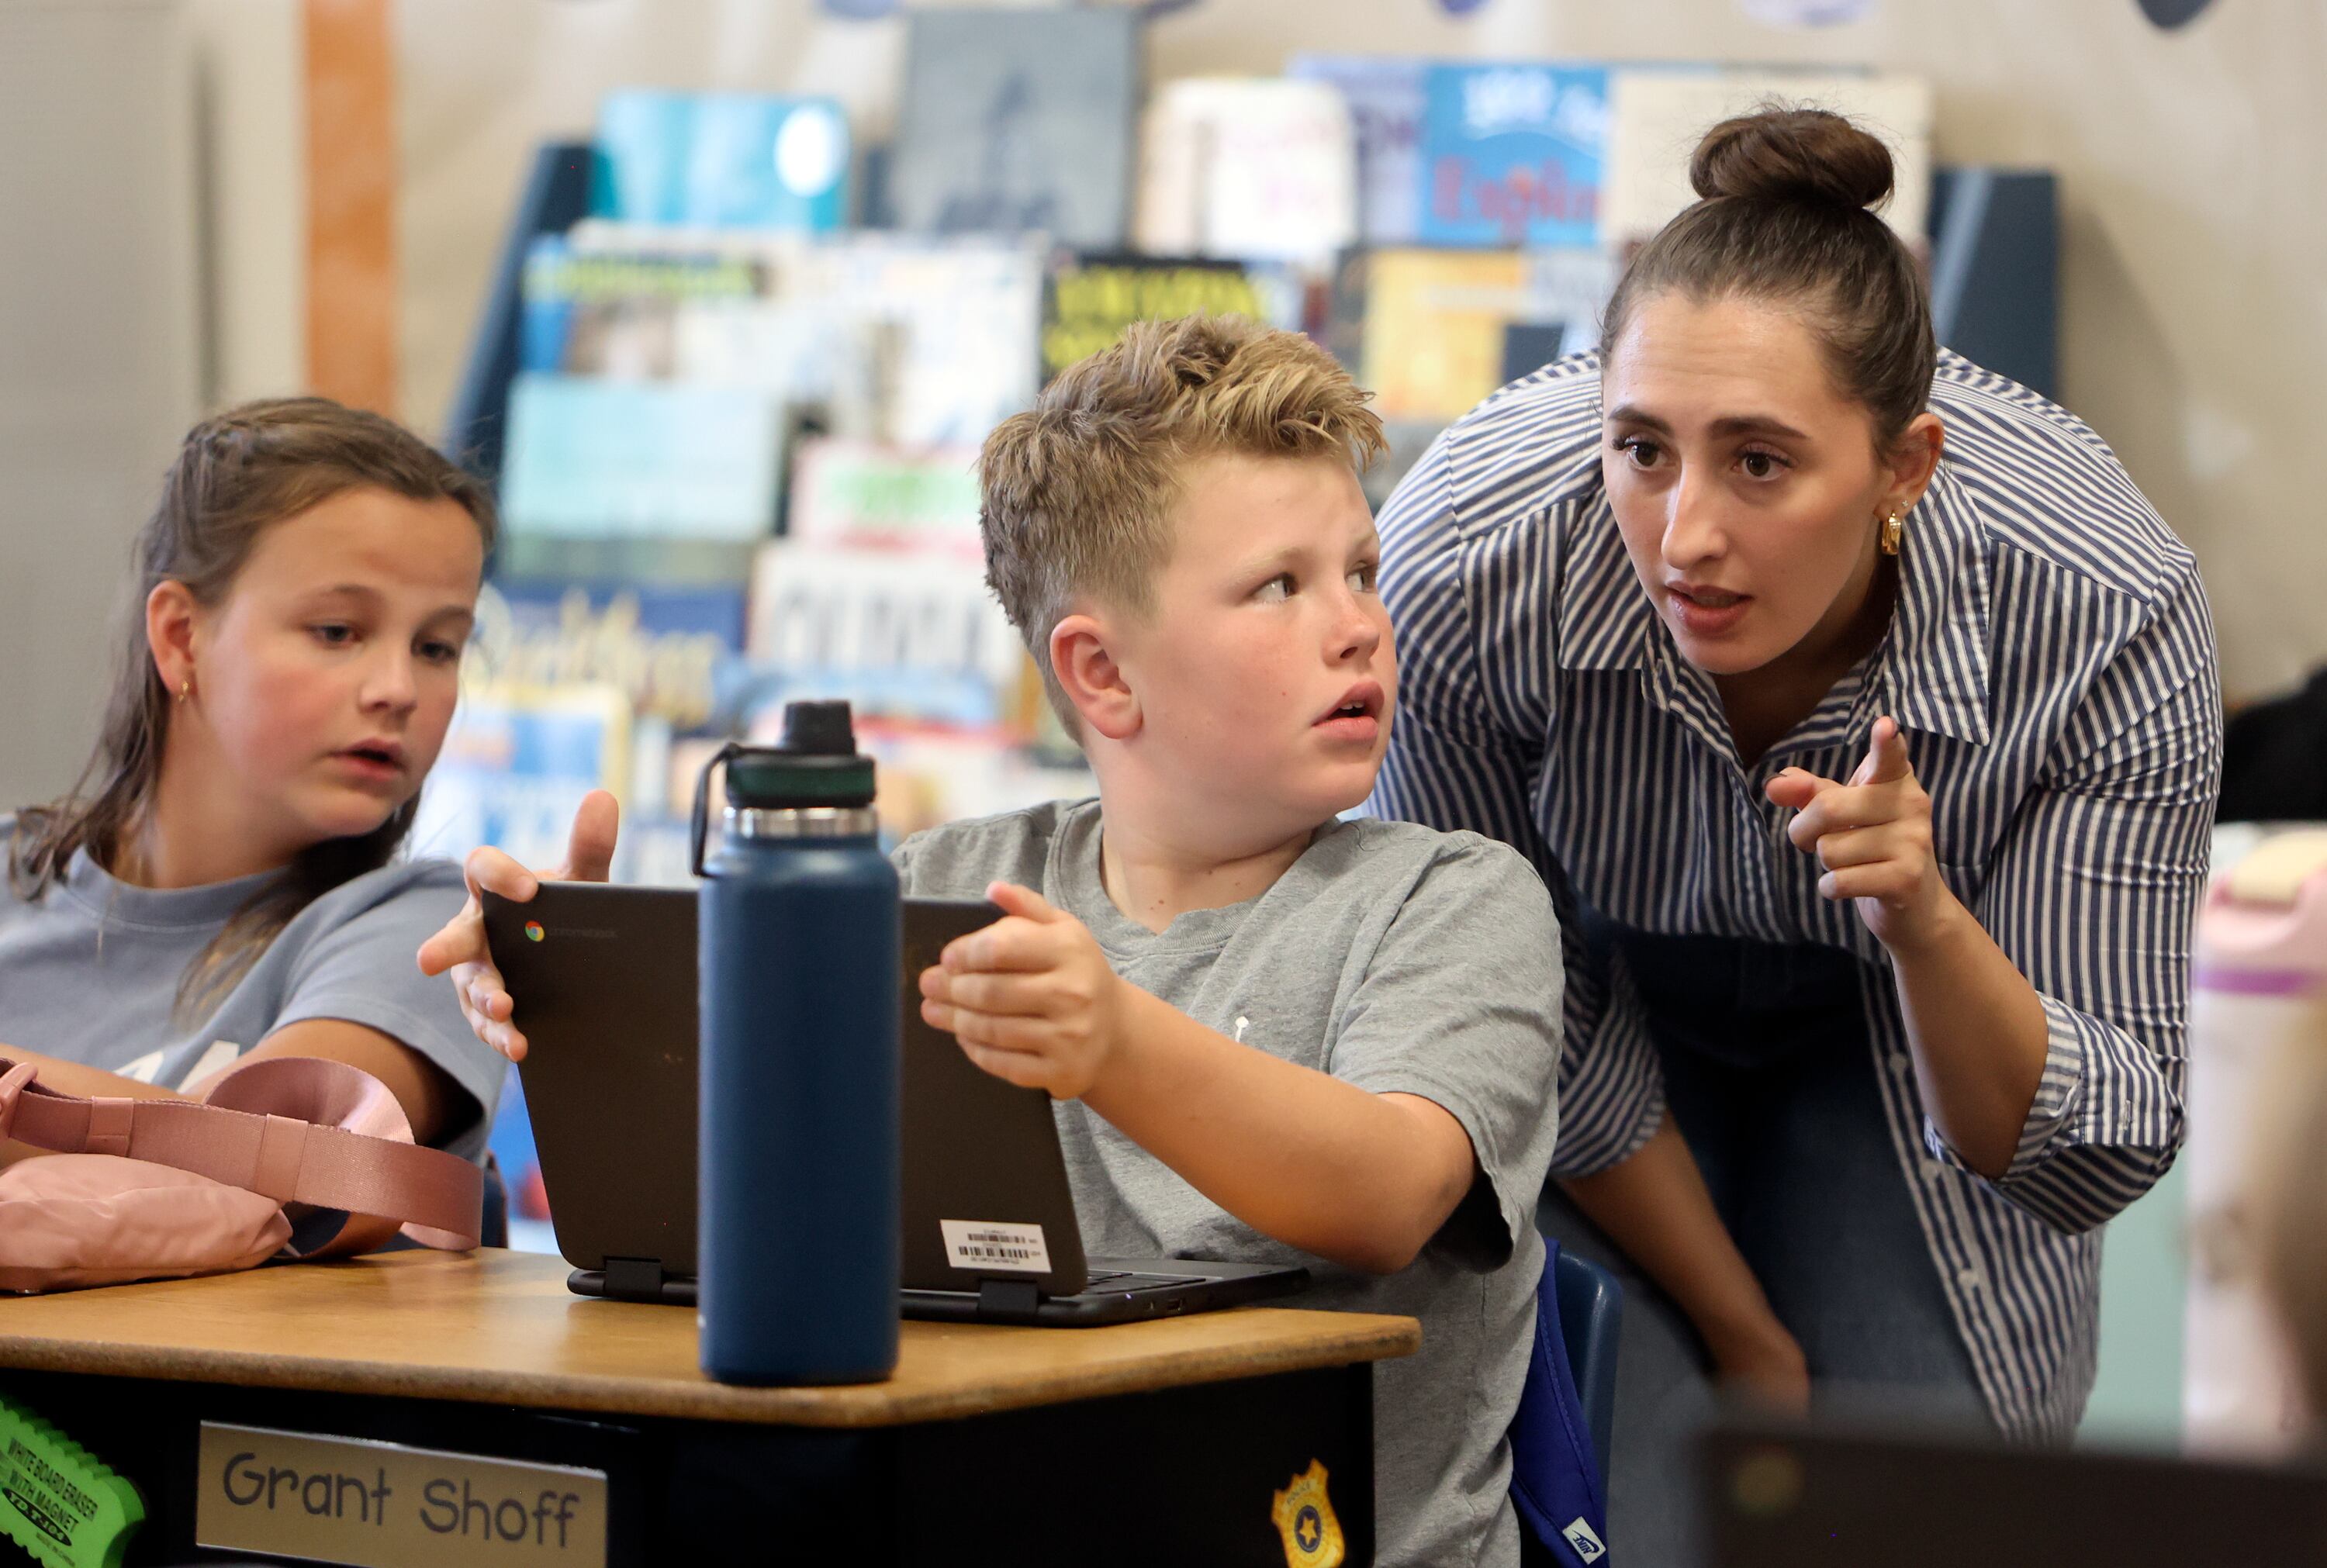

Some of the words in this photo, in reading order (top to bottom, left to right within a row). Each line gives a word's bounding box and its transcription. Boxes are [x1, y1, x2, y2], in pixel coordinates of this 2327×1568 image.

[7, 1438, 36, 1472] WHITE
[33, 1459, 66, 1494] BOARD
[62, 1481, 99, 1521] ERASER
[9, 1470, 37, 1502] WITH
[36, 1490, 79, 1533] MAGNET
[223, 1452, 391, 1525] Grant
[420, 1475, 579, 1549] Shoff
